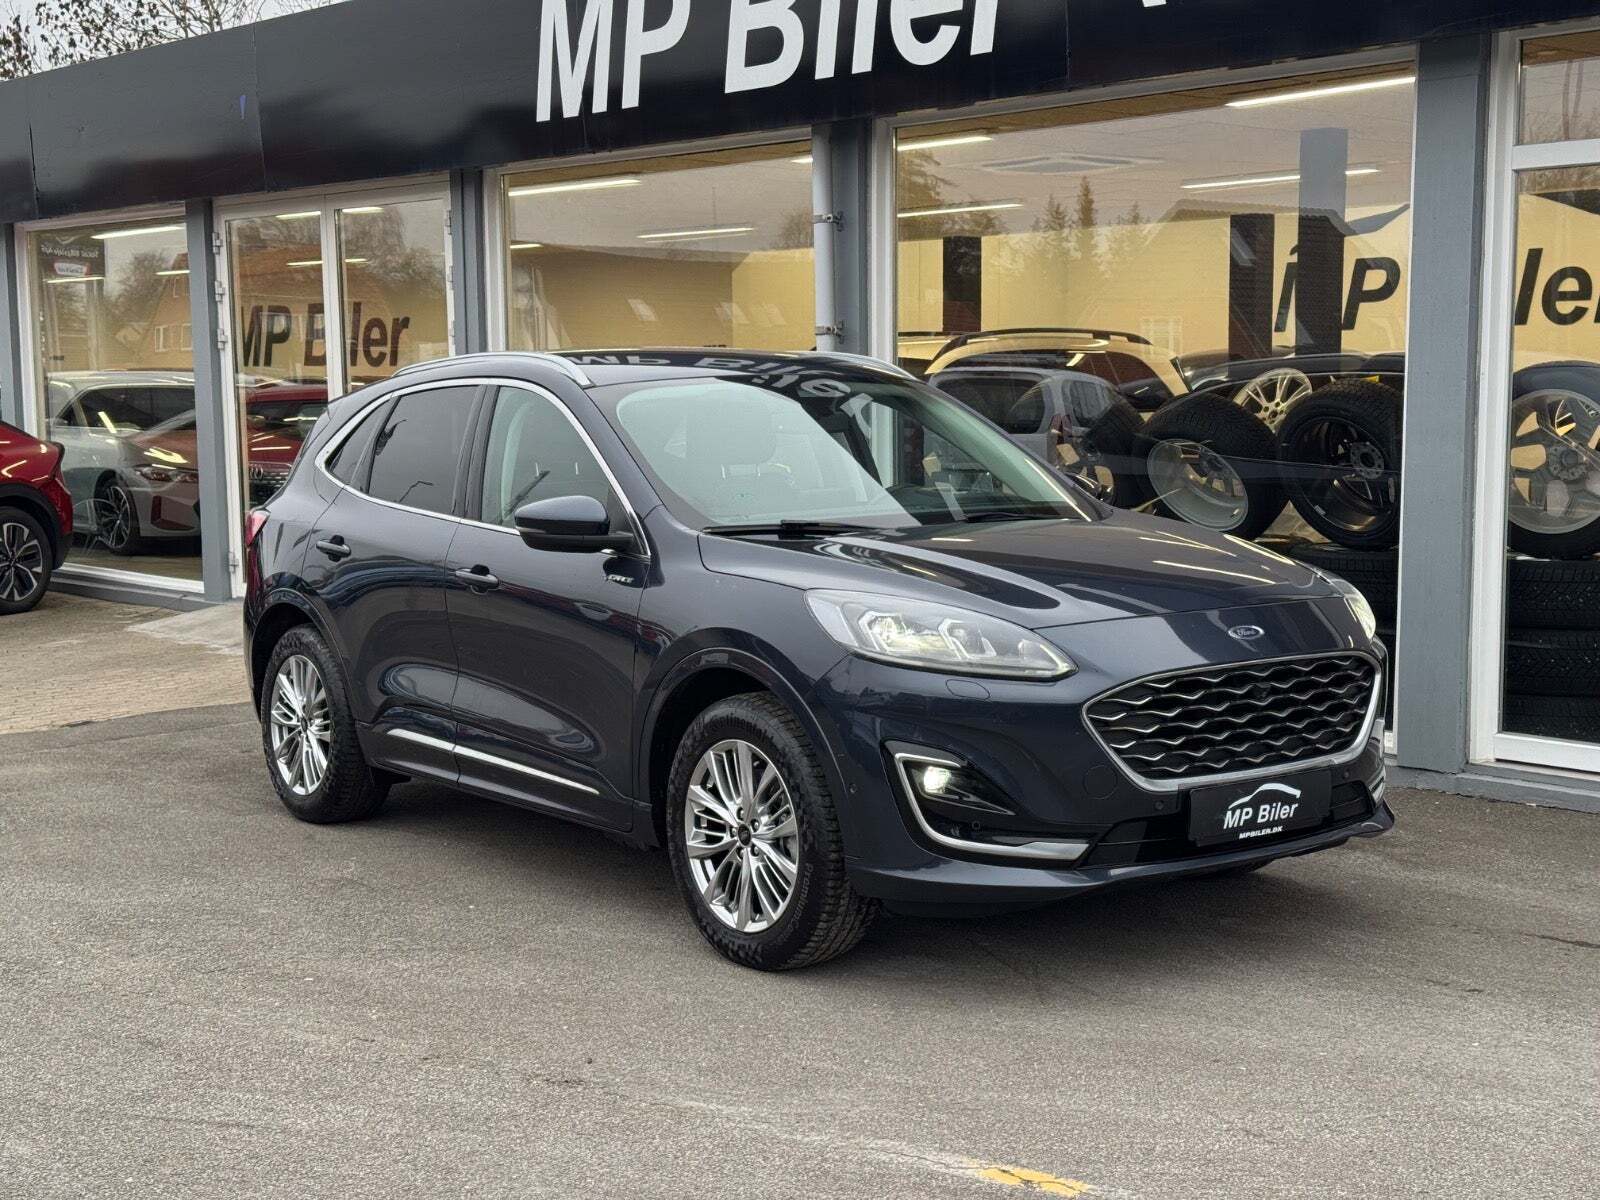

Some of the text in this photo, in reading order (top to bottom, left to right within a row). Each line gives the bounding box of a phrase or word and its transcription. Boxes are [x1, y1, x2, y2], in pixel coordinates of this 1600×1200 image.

[536, 0, 691, 122] MP
[303, 301, 410, 367] Bler
[1223, 801, 1299, 830] MP Biler
[1238, 825, 1284, 840] MPBILER.DK
